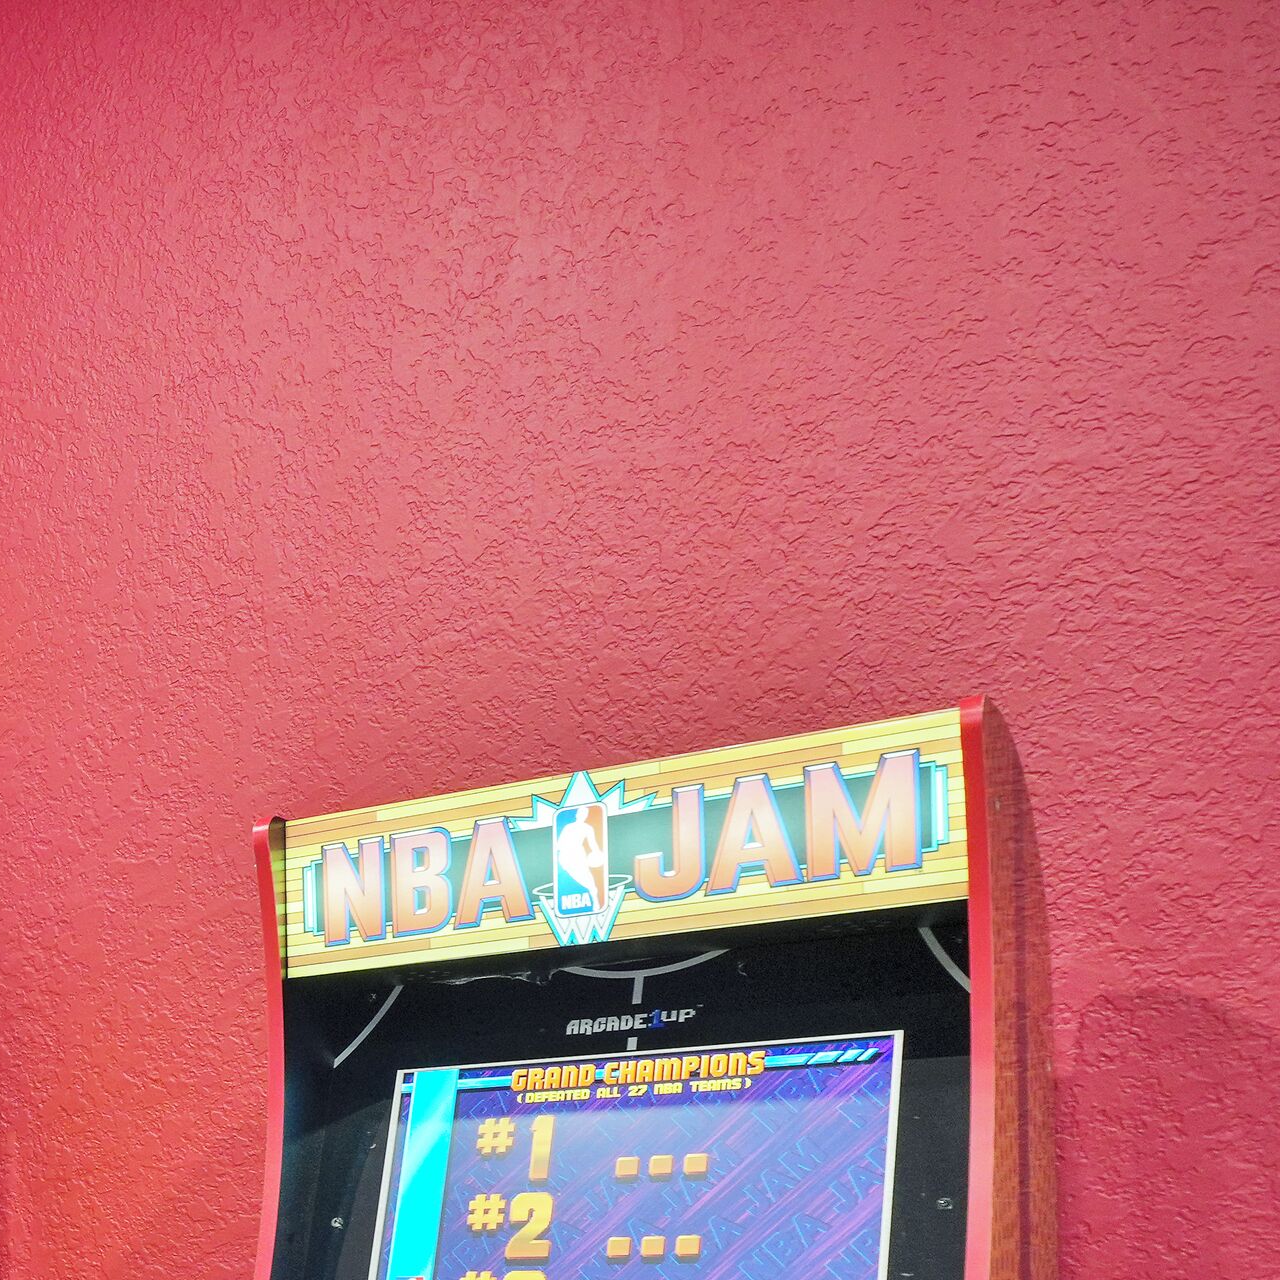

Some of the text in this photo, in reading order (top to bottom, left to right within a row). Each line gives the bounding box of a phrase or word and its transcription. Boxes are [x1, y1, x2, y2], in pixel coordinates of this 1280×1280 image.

[321, 748, 923, 947] NBA NBA JAM
[510, 1050, 766, 1092] GRAND CHAMPIONS
[596, 1086, 621, 1099] ALL
[627, 1084, 647, 1097] 27
[653, 1082, 682, 1095] NBA
